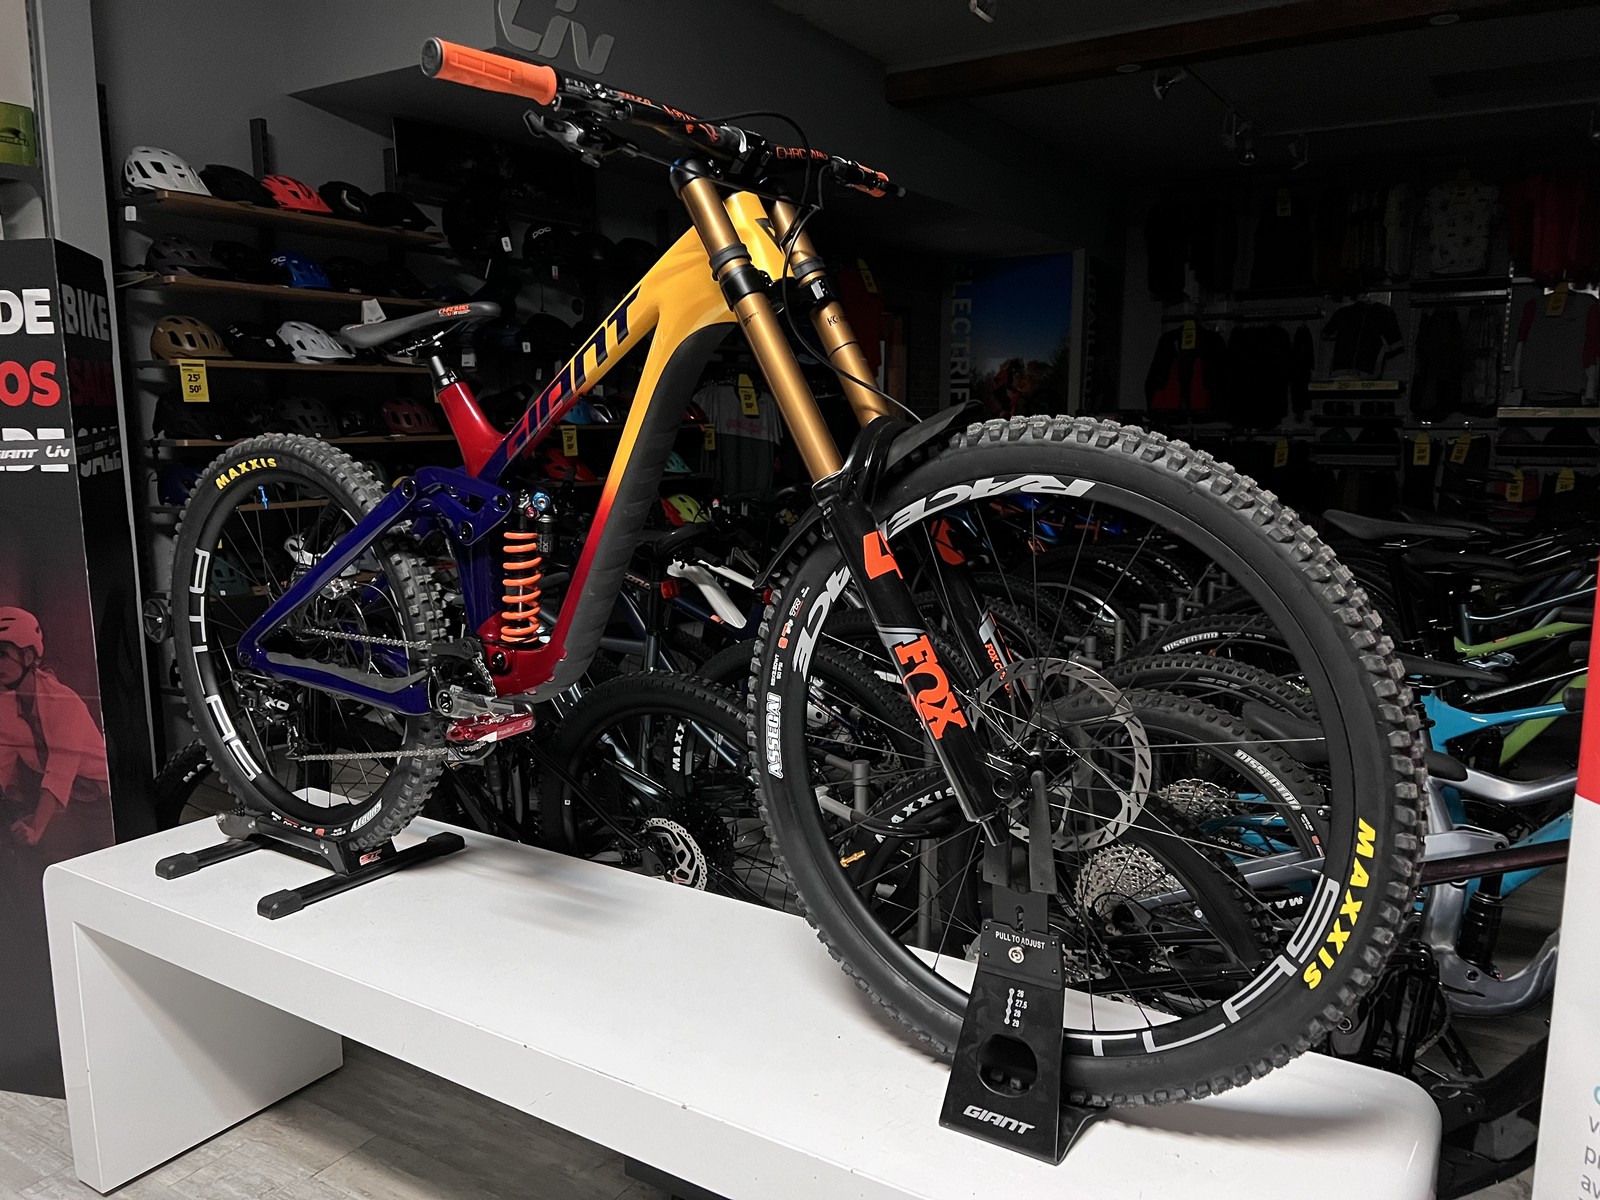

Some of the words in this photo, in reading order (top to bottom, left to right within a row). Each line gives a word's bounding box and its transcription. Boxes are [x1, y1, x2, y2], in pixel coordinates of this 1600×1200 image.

[61, 283, 110, 341] BIKE
[0, 360, 62, 407] OS
[45, 445, 71, 458] Liv
[214, 456, 278, 491] MAXXIS
[886, 474, 1096, 541] RACE
[792, 565, 852, 684] ACE
[984, 643, 999, 663] FOX
[894, 634, 968, 740] FOX
[671, 721, 687, 772] MAXX
[766, 692, 784, 780] ASSEGAI
[1303, 817, 1377, 990] MAXXIS
[995, 930, 1011, 942] PULL
[1011, 934, 1021, 944] TO
[1020, 937, 1046, 950] ADJUST
[1015, 999, 1028, 1010] 27.5
[963, 1104, 1036, 1135] GIANT
